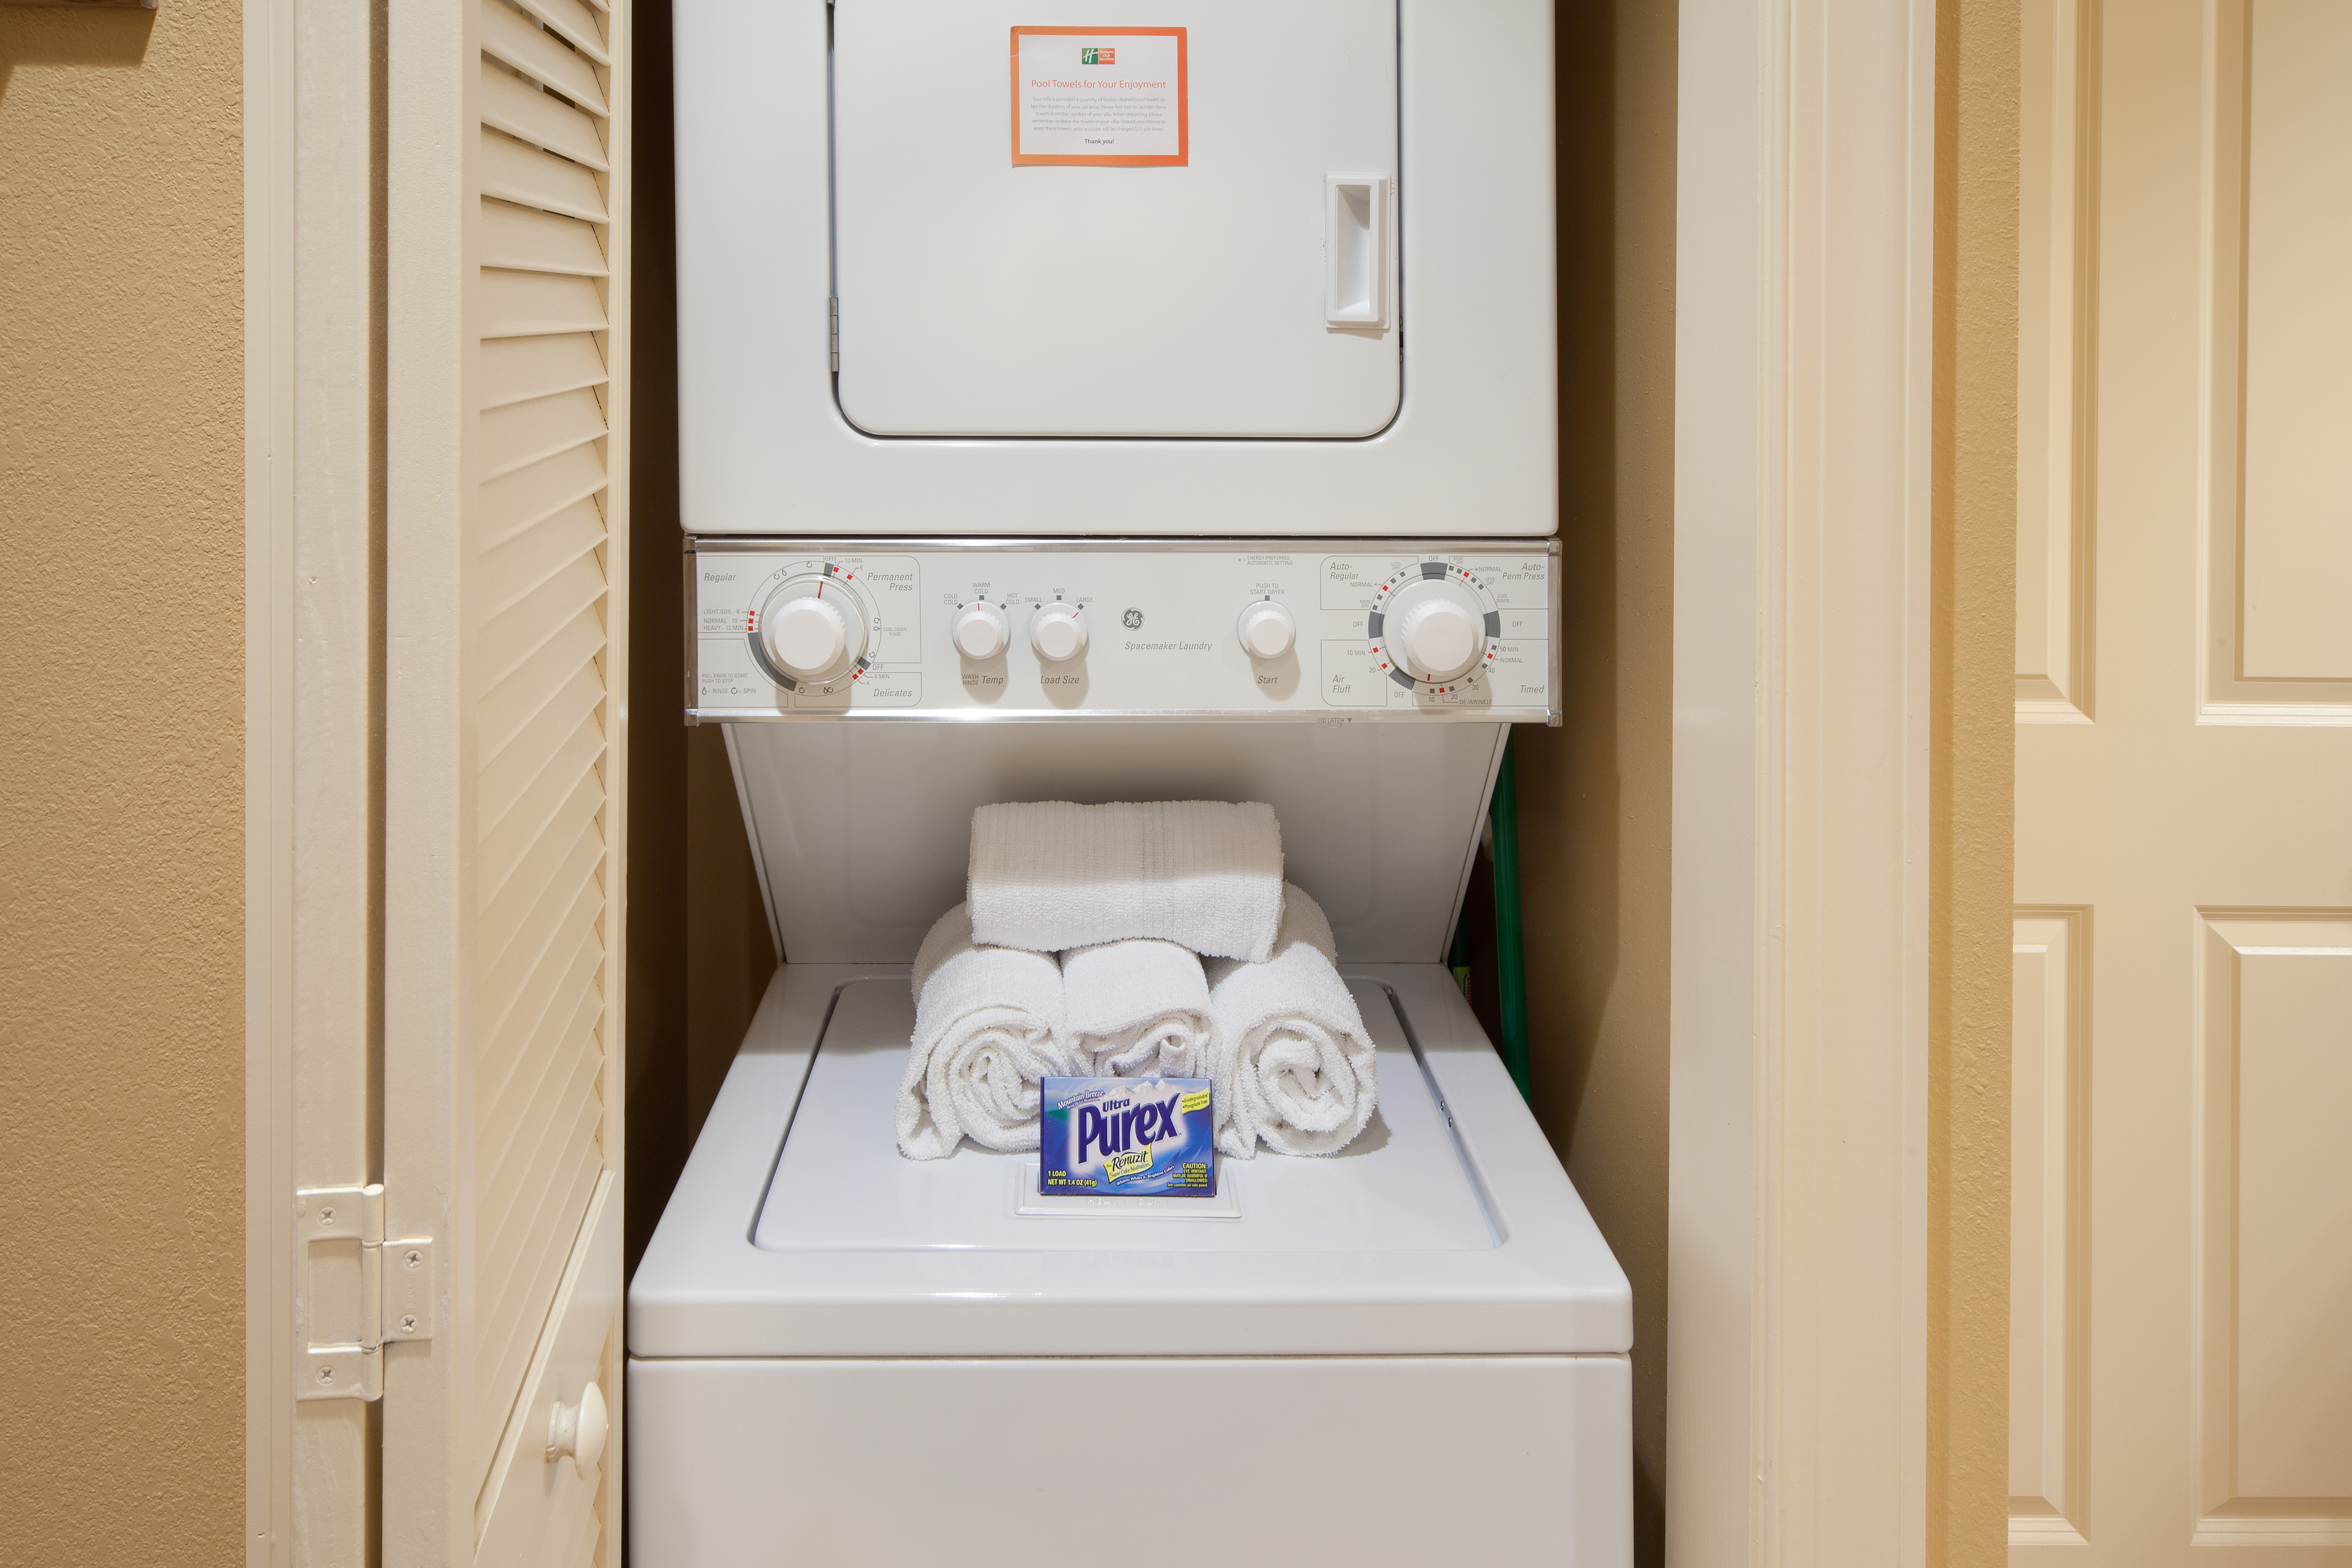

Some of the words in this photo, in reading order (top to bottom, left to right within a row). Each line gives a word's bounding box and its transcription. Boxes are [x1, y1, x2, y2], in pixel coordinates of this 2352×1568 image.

[1052, 80, 1081, 88] Towels
[1084, 80, 1095, 88] for
[1120, 80, 1166, 90] Enjoyment
[704, 573, 737, 582] Regular
[868, 573, 913, 581] Permanent
[1330, 572, 1359, 580] Regular
[1125, 642, 1177, 651] Spacemaker
[1179, 642, 1212, 651] Laundry
[982, 676, 1003, 684] Temp
[1040, 676, 1060, 684] Load
[1062, 676, 1080, 684] Size
[1258, 675, 1278, 684] Start
[1333, 675, 1345, 683] Air
[874, 689, 912, 697] Delicates
[1333, 685, 1351, 693] Fluff
[1521, 685, 1544, 693] Timed
[1058, 1092, 1085, 1110] Mountain
[1102, 1098, 1130, 1112] Ultra
[1078, 1093, 1181, 1164] Purex
[1112, 1151, 1148, 1171] Renuzit
[1084, 1179, 1097, 1187] (41g)
